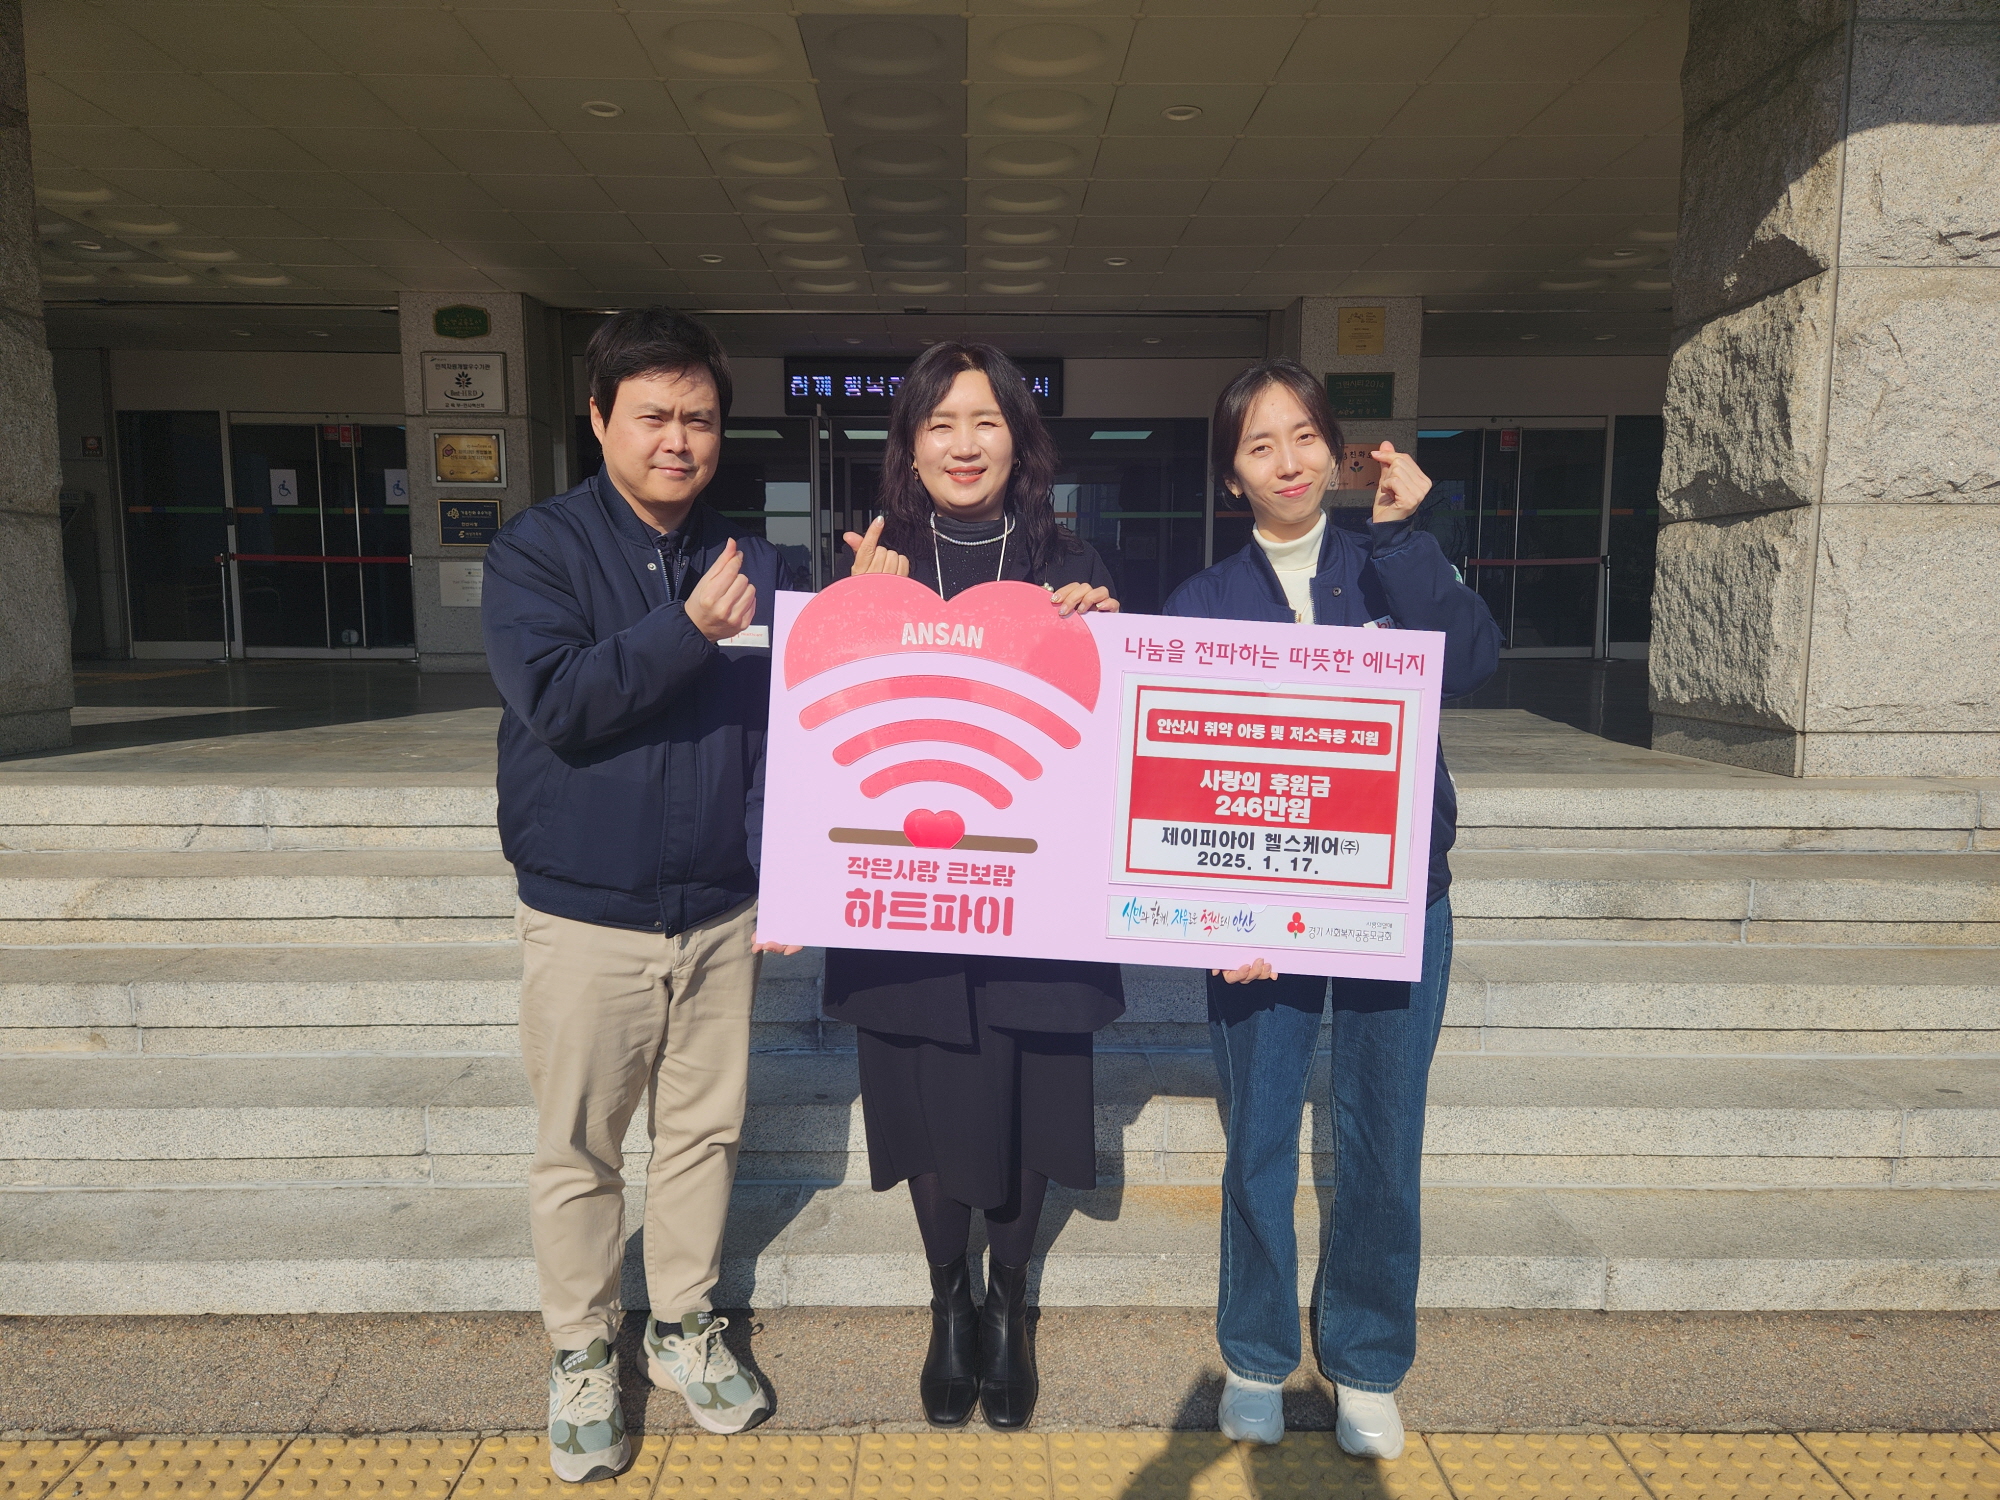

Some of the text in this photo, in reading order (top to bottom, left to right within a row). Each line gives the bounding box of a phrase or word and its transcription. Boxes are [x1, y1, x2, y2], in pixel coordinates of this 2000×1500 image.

[791, 376, 832, 397] 함께
[844, 376, 905, 397] 행복
[901, 622, 984, 649] ANSAN
[1124, 637, 1426, 677] 나눔을 전파하는 따뜻한 에너지
[1157, 718, 1380, 748] 안산시 취약 아동 및 저소득층 지원
[1200, 769, 1331, 798] 사랑의 후원금
[1215, 795, 1311, 824] 246만원
[1161, 826, 1256, 852] 제이피아이
[846, 856, 1016, 887] 작은사랑 큰보람
[1197, 851, 1319, 875] 2025. 1. 17.
[844, 887, 1015, 936] 하트파이
[1232, 909, 1257, 933] 안산
[1308, 926, 1392, 943] 경기 사회복지공동모금회
